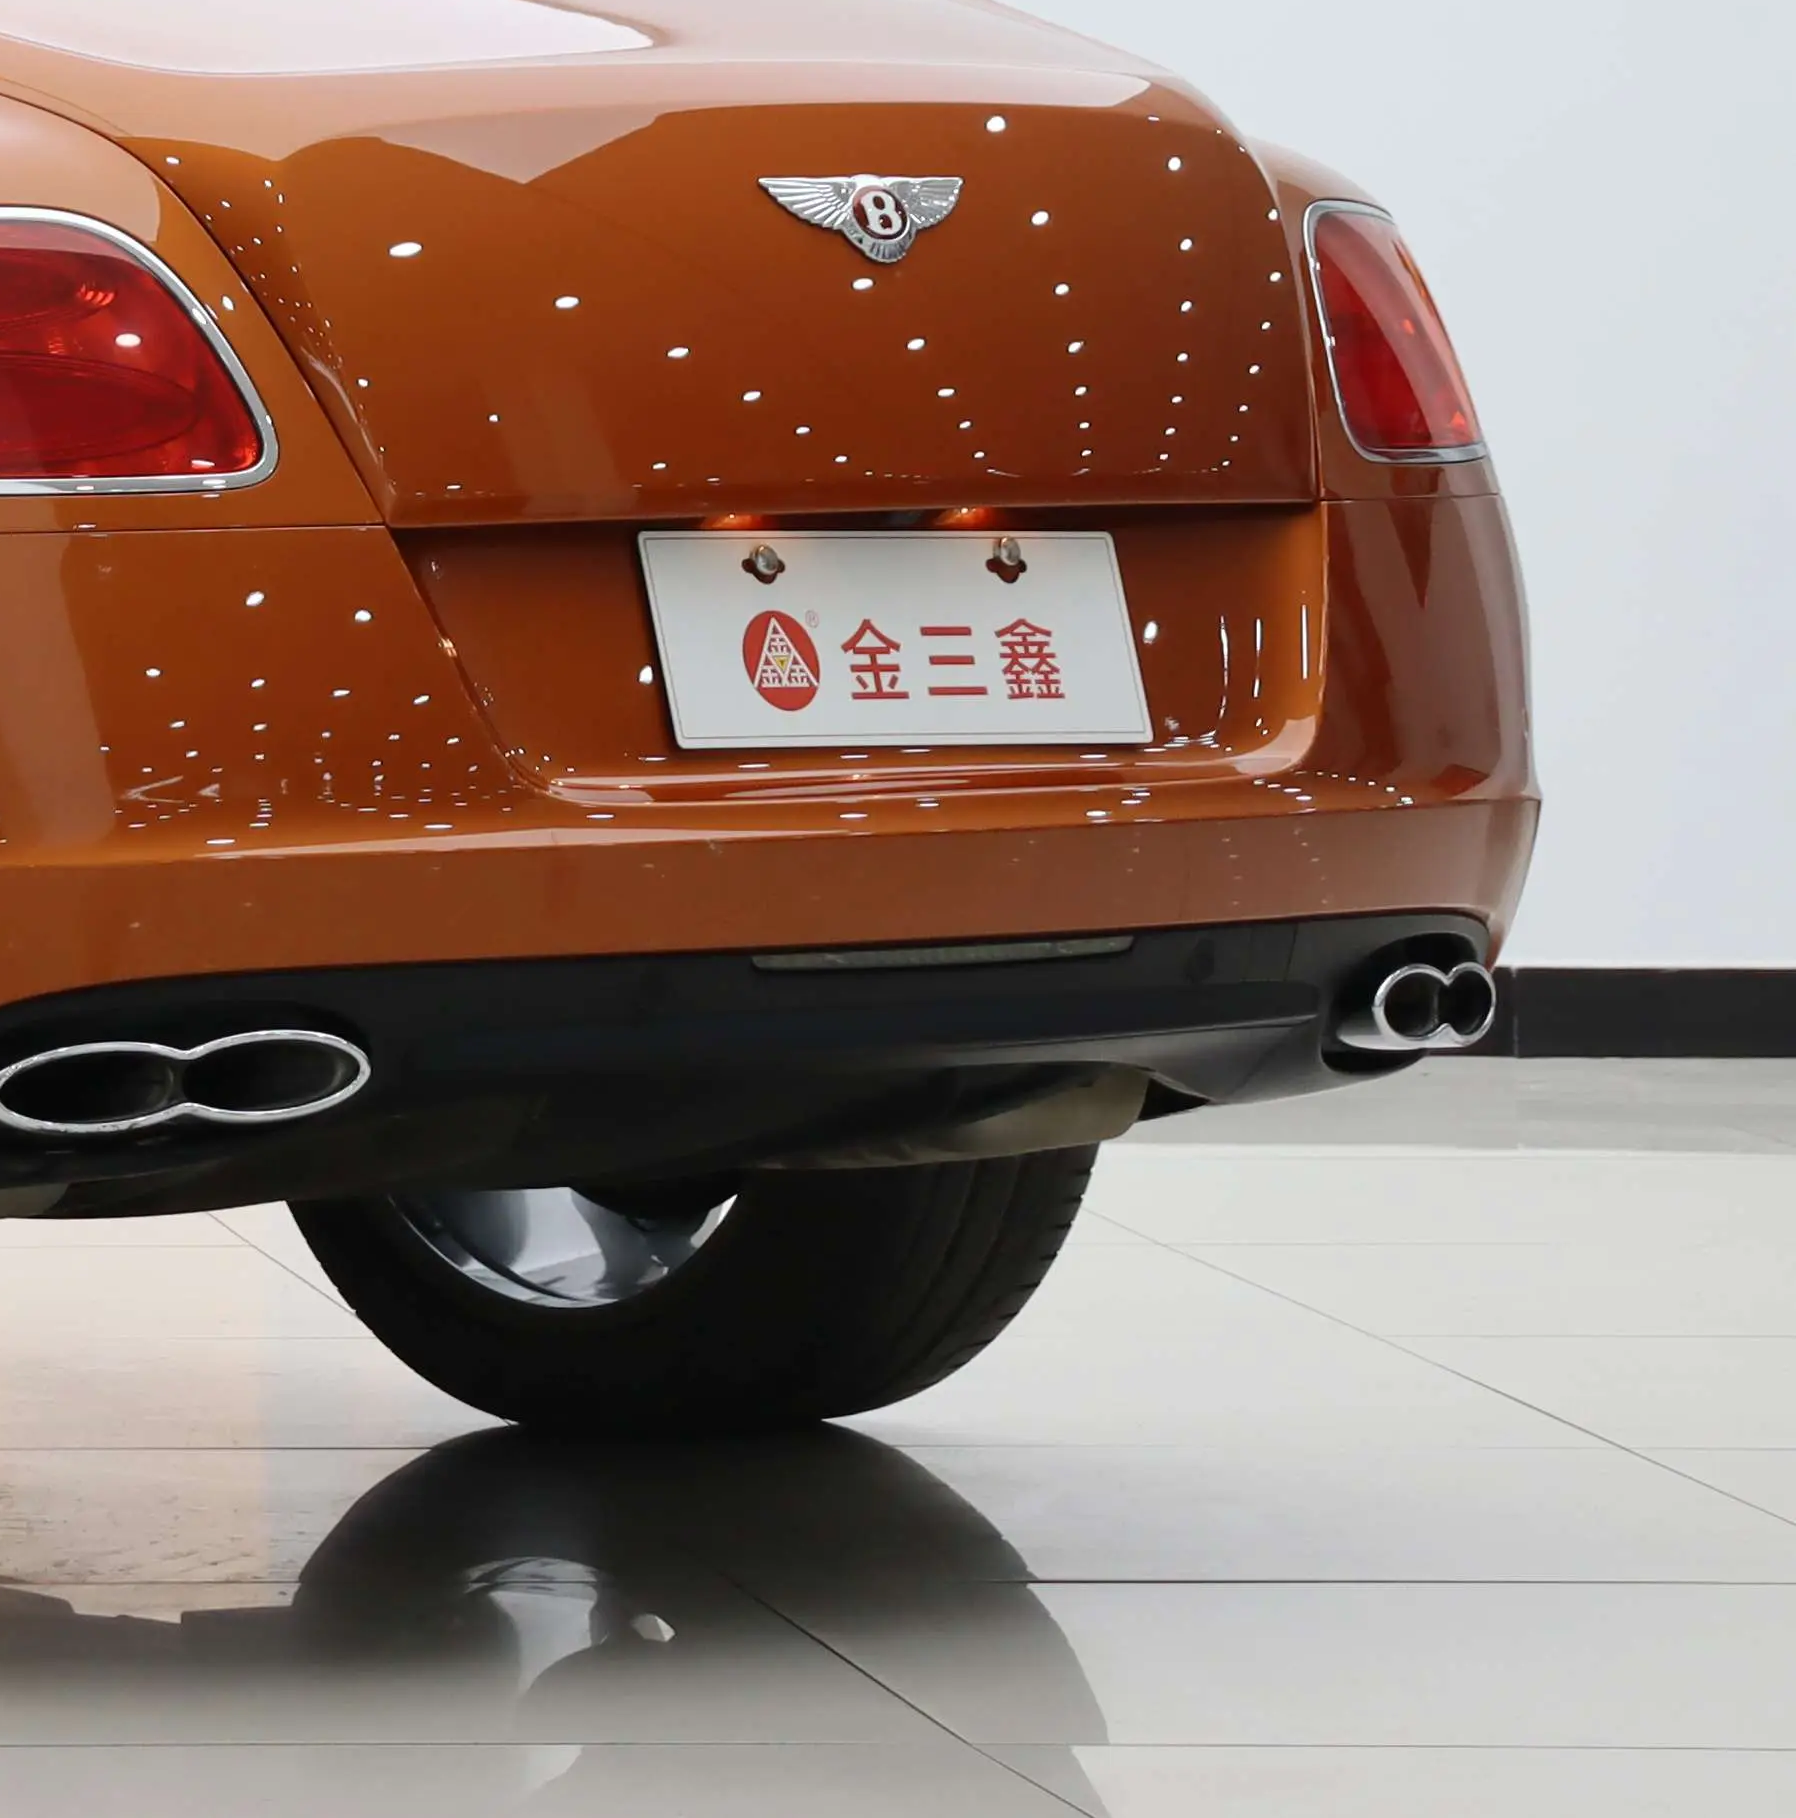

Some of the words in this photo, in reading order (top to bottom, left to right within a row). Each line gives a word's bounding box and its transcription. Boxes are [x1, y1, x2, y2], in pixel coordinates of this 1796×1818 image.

[860, 190, 903, 236] B
[840, 618, 1064, 700] 金三鑫
